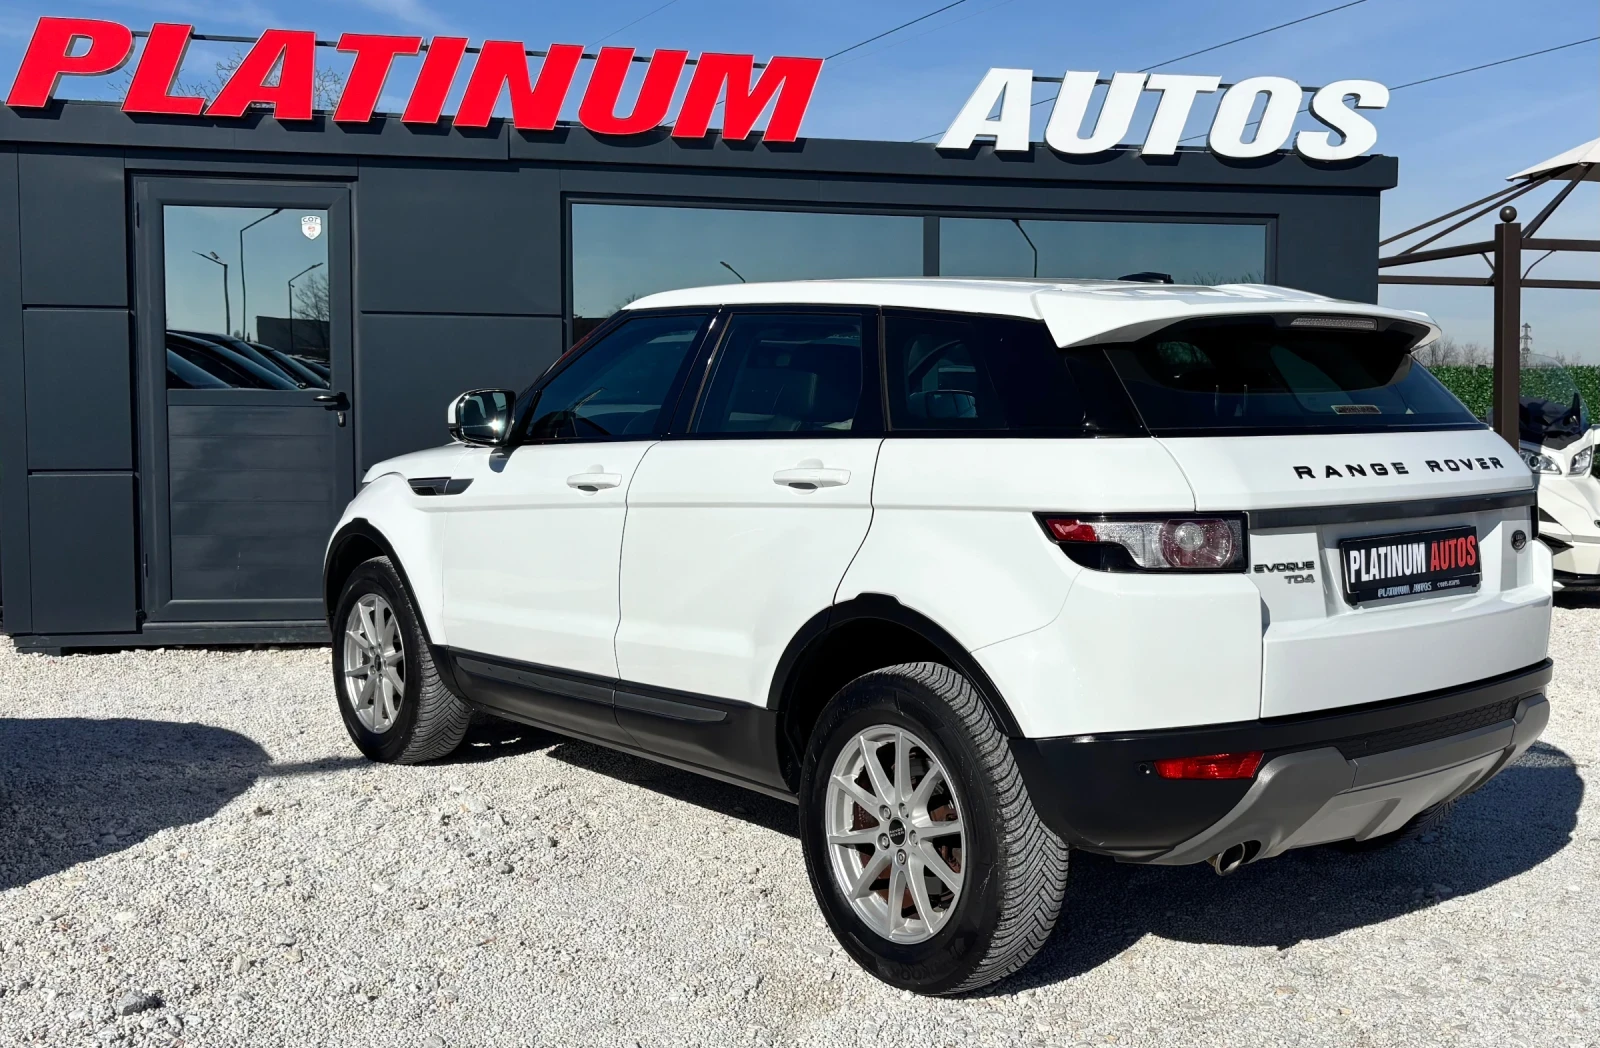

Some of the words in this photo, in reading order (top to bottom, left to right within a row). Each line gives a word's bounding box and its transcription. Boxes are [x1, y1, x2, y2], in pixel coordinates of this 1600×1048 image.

[5, 16, 824, 142] PLATINUM
[936, 67, 1390, 161] AUTOS
[1293, 462, 1409, 480] RANGE
[1425, 456, 1504, 473] ROVER
[1253, 561, 1315, 573] EVOQUE
[1350, 541, 1426, 583] PLATINUM
[1430, 535, 1477, 571] AUTOS
[1284, 574, 1316, 584] TD4
